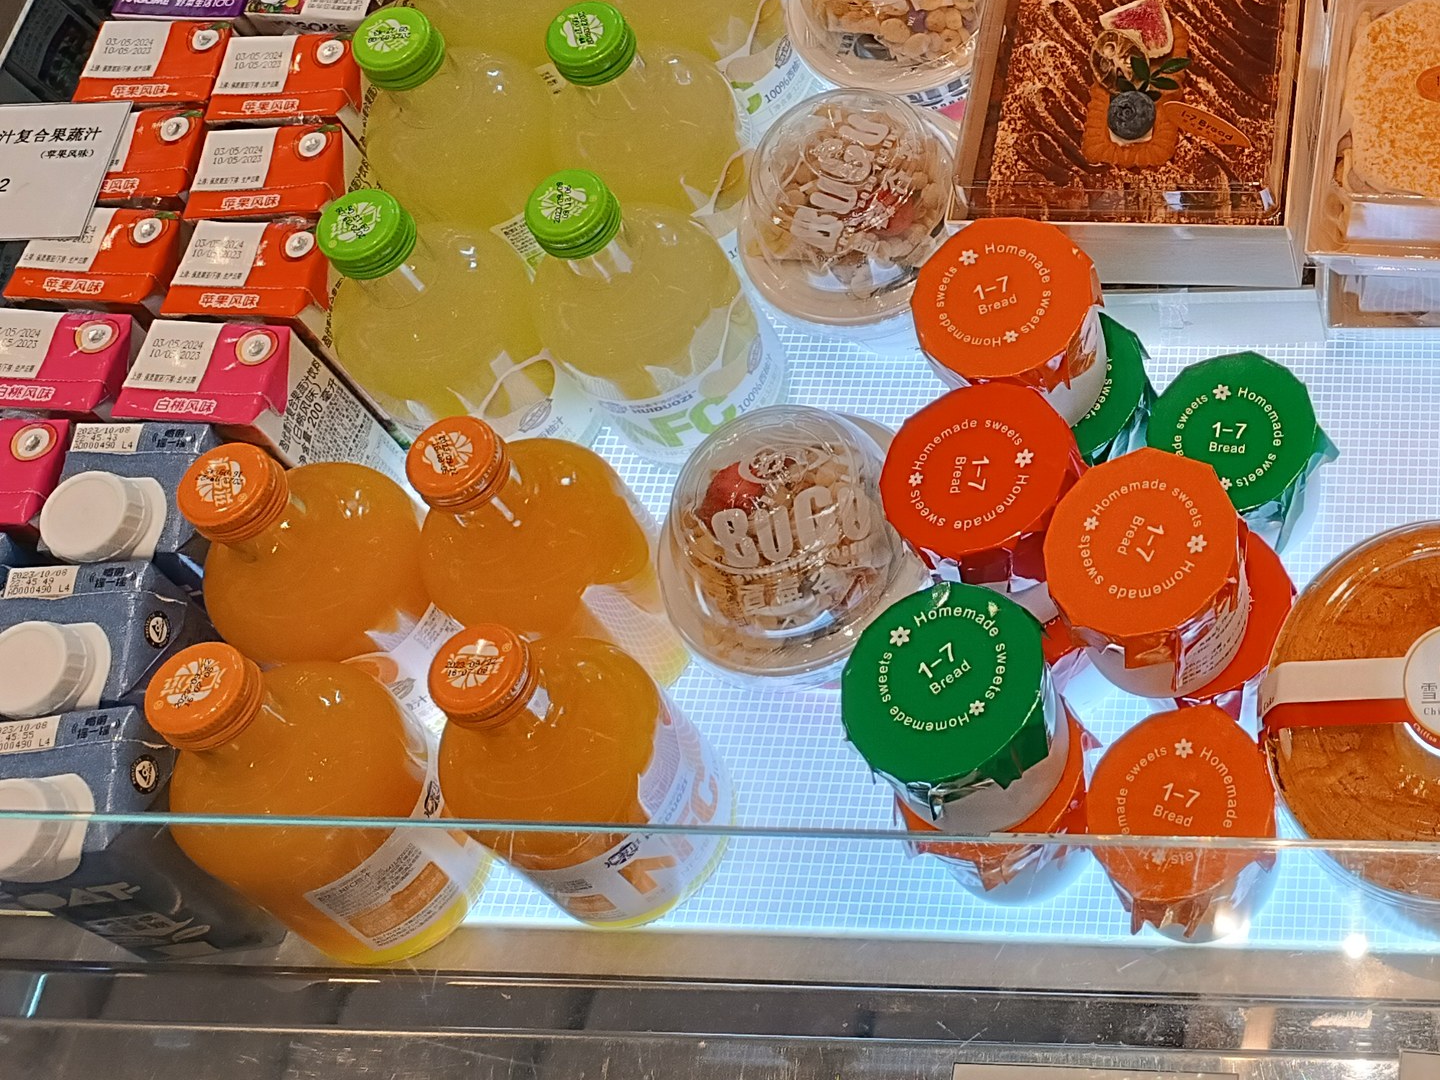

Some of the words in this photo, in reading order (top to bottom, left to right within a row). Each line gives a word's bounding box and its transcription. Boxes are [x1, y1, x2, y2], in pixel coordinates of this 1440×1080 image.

[113, 84, 168, 96] 苹果风味
[244, 100, 298, 112] 苹果风味
[1199, 120, 1233, 141] Bread
[222, 195, 279, 208] 苹果风味
[984, 242, 1050, 283] Homemade
[45, 278, 103, 294] 苹果风味
[200, 294, 259, 308] 苹果风味
[936, 266, 957, 308] sweets
[973, 275, 1008, 300] 1-7
[978, 294, 1017, 315] Bread
[1020, 290, 1051, 334] sweets
[938, 312, 1001, 347] Homemade
[155, 399, 216, 413] 白桃风味
[1177, 393, 1208, 430] sweets
[1237, 387, 1281, 446] Homemade
[912, 419, 977, 470] Homemade
[985, 419, 1022, 446] sweets
[1209, 441, 1246, 454] Bread
[1212, 421, 1247, 439] 1-7
[949, 456, 966, 494] Bread
[968, 456, 990, 490] 1-7
[1236, 452, 1276, 488] sweets
[910, 489, 946, 526] sweets
[953, 474, 1029, 530] Homemade
[1091, 480, 1167, 515] Homemade
[1171, 487, 1202, 527] sweets
[1117, 515, 1144, 555] Bread
[1136, 524, 1164, 562] 1-7
[1078, 534, 1104, 585] sweets
[1108, 560, 1195, 599] Homemade
[914, 605, 999, 637] Homemade
[878, 651, 892, 703] sweets
[918, 641, 955, 678] 1-7
[929, 658, 971, 695] Bread
[985, 643, 1007, 700] sweets
[889, 704, 970, 731] Homemade
[1125, 746, 1167, 782] sweets
[1162, 782, 1200, 808] 1-7
[1199, 746, 1239, 828] Homemade
[1152, 804, 1193, 828] Bread
